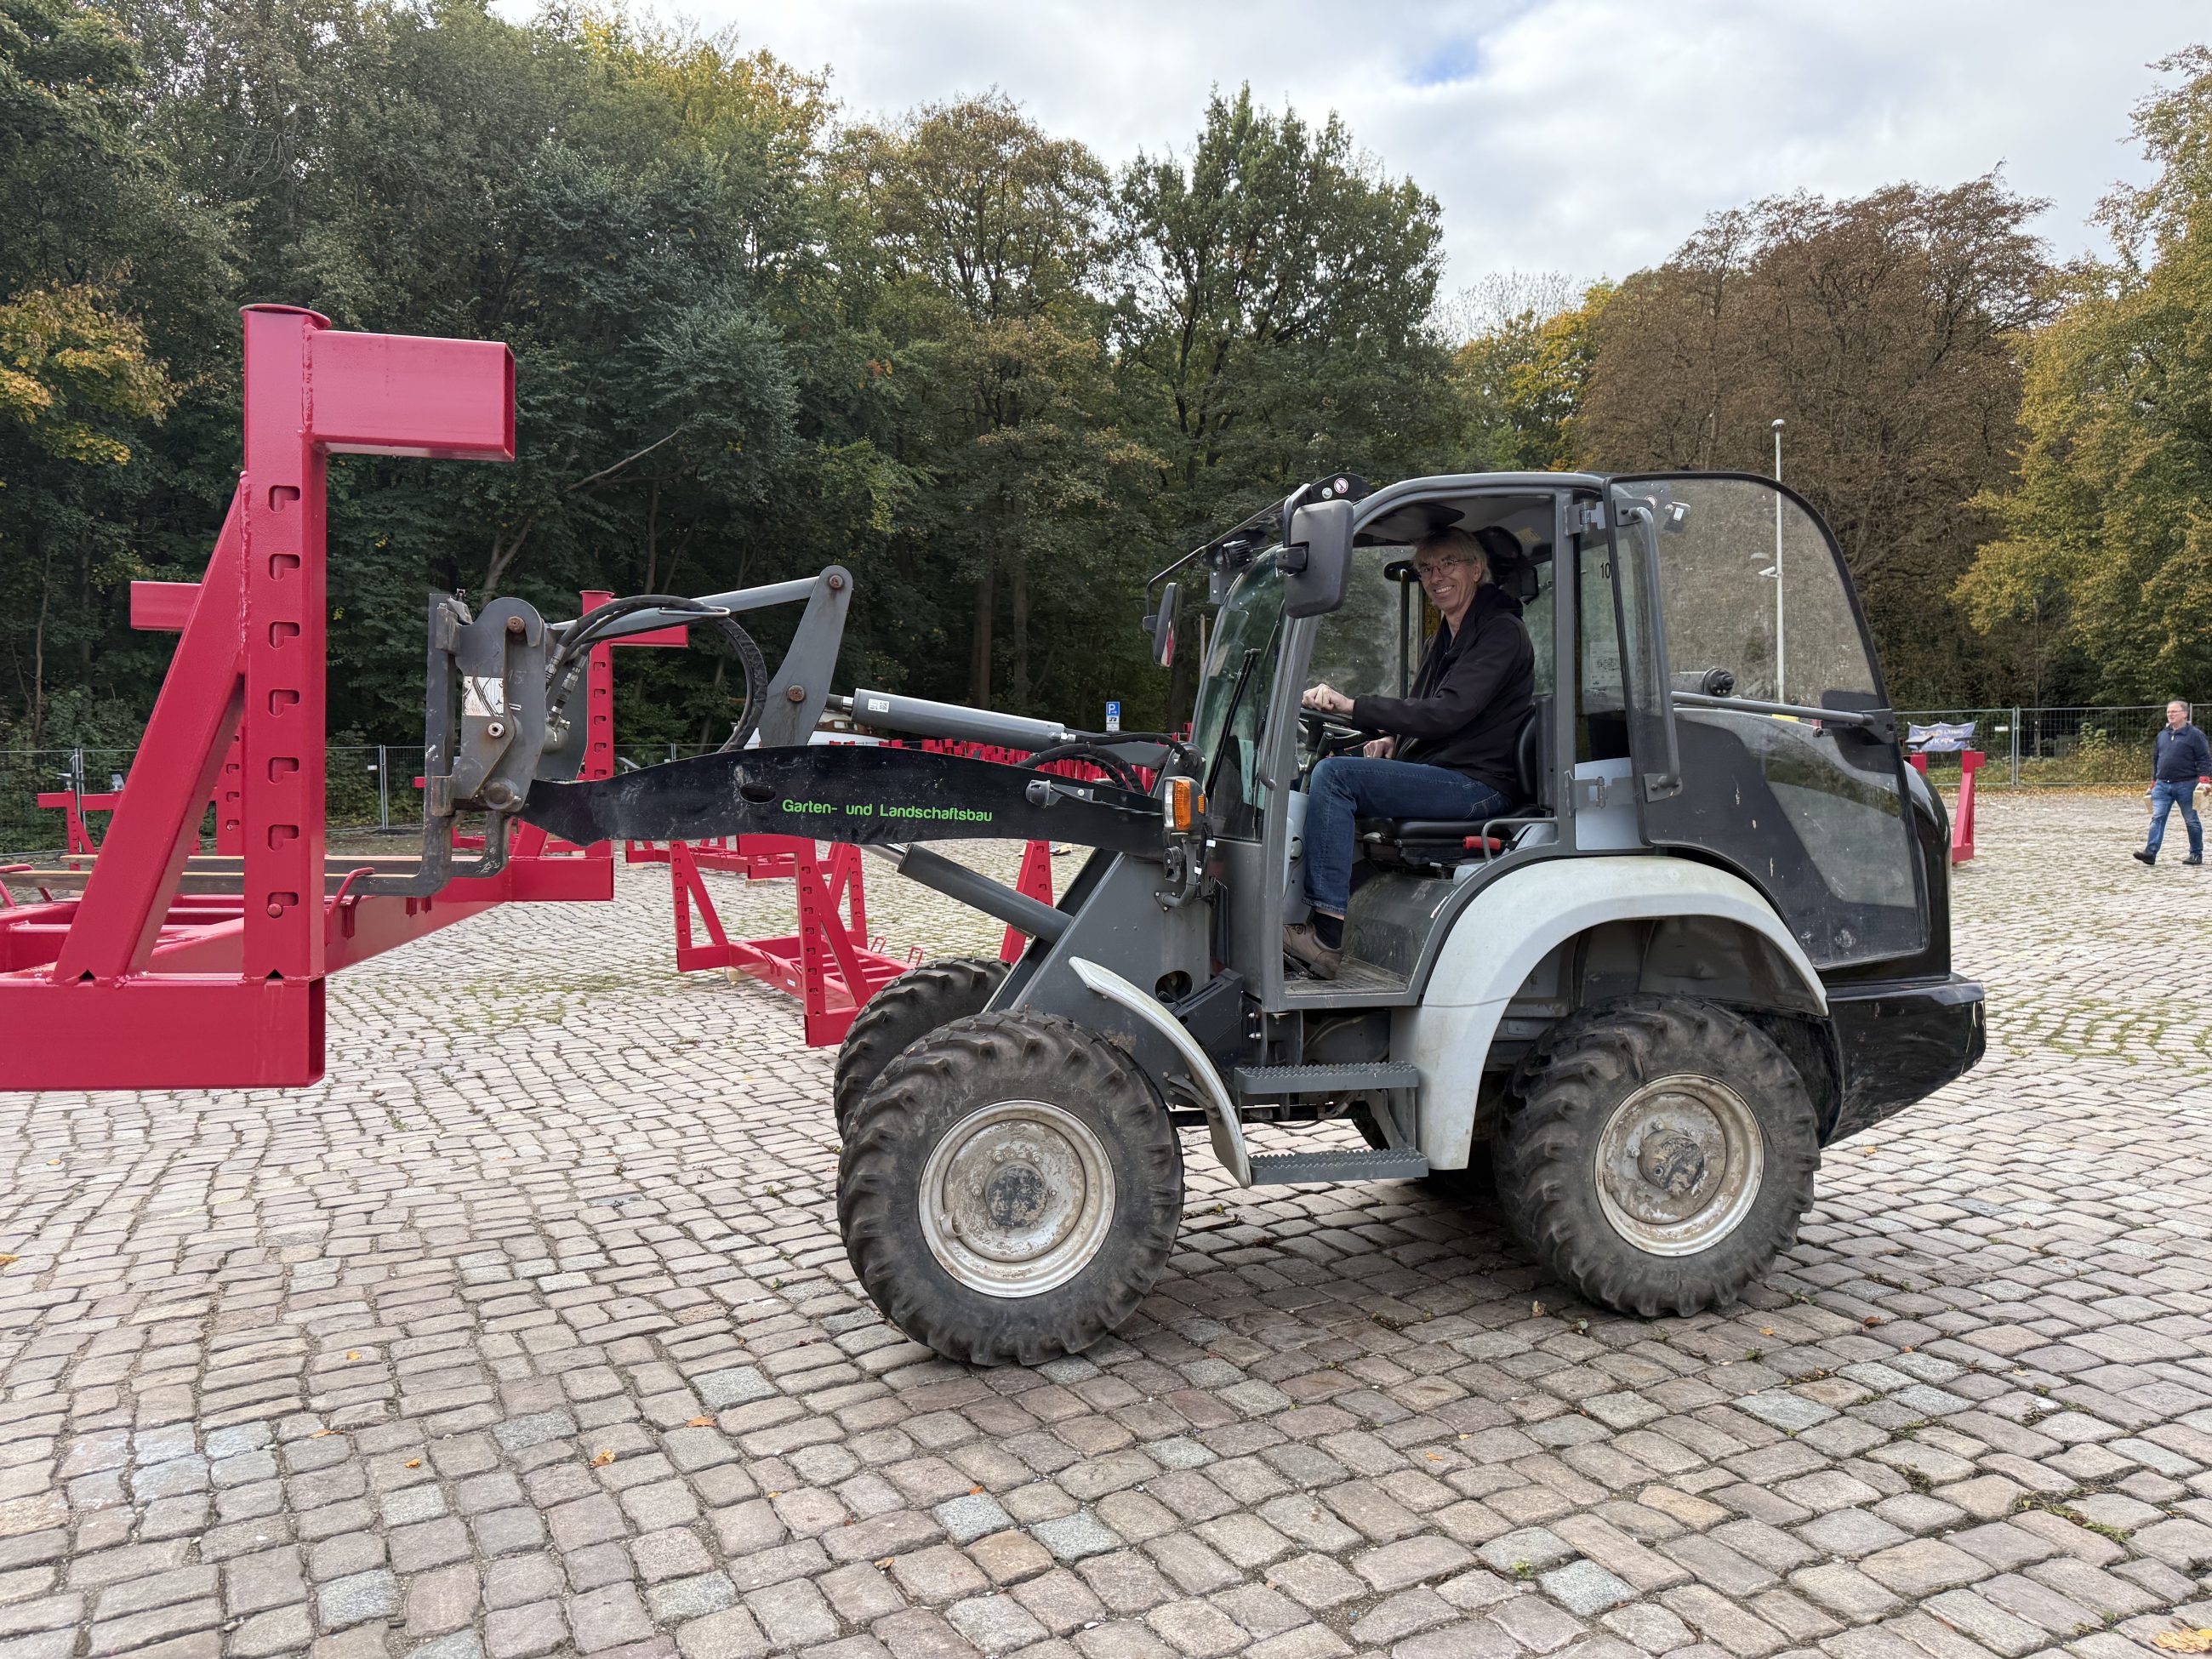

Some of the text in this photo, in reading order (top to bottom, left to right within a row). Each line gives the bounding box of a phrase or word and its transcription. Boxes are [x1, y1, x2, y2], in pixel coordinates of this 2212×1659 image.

[1108, 703, 1116, 715] P
[782, 799, 993, 822] Garten- und Landschaftsbau
